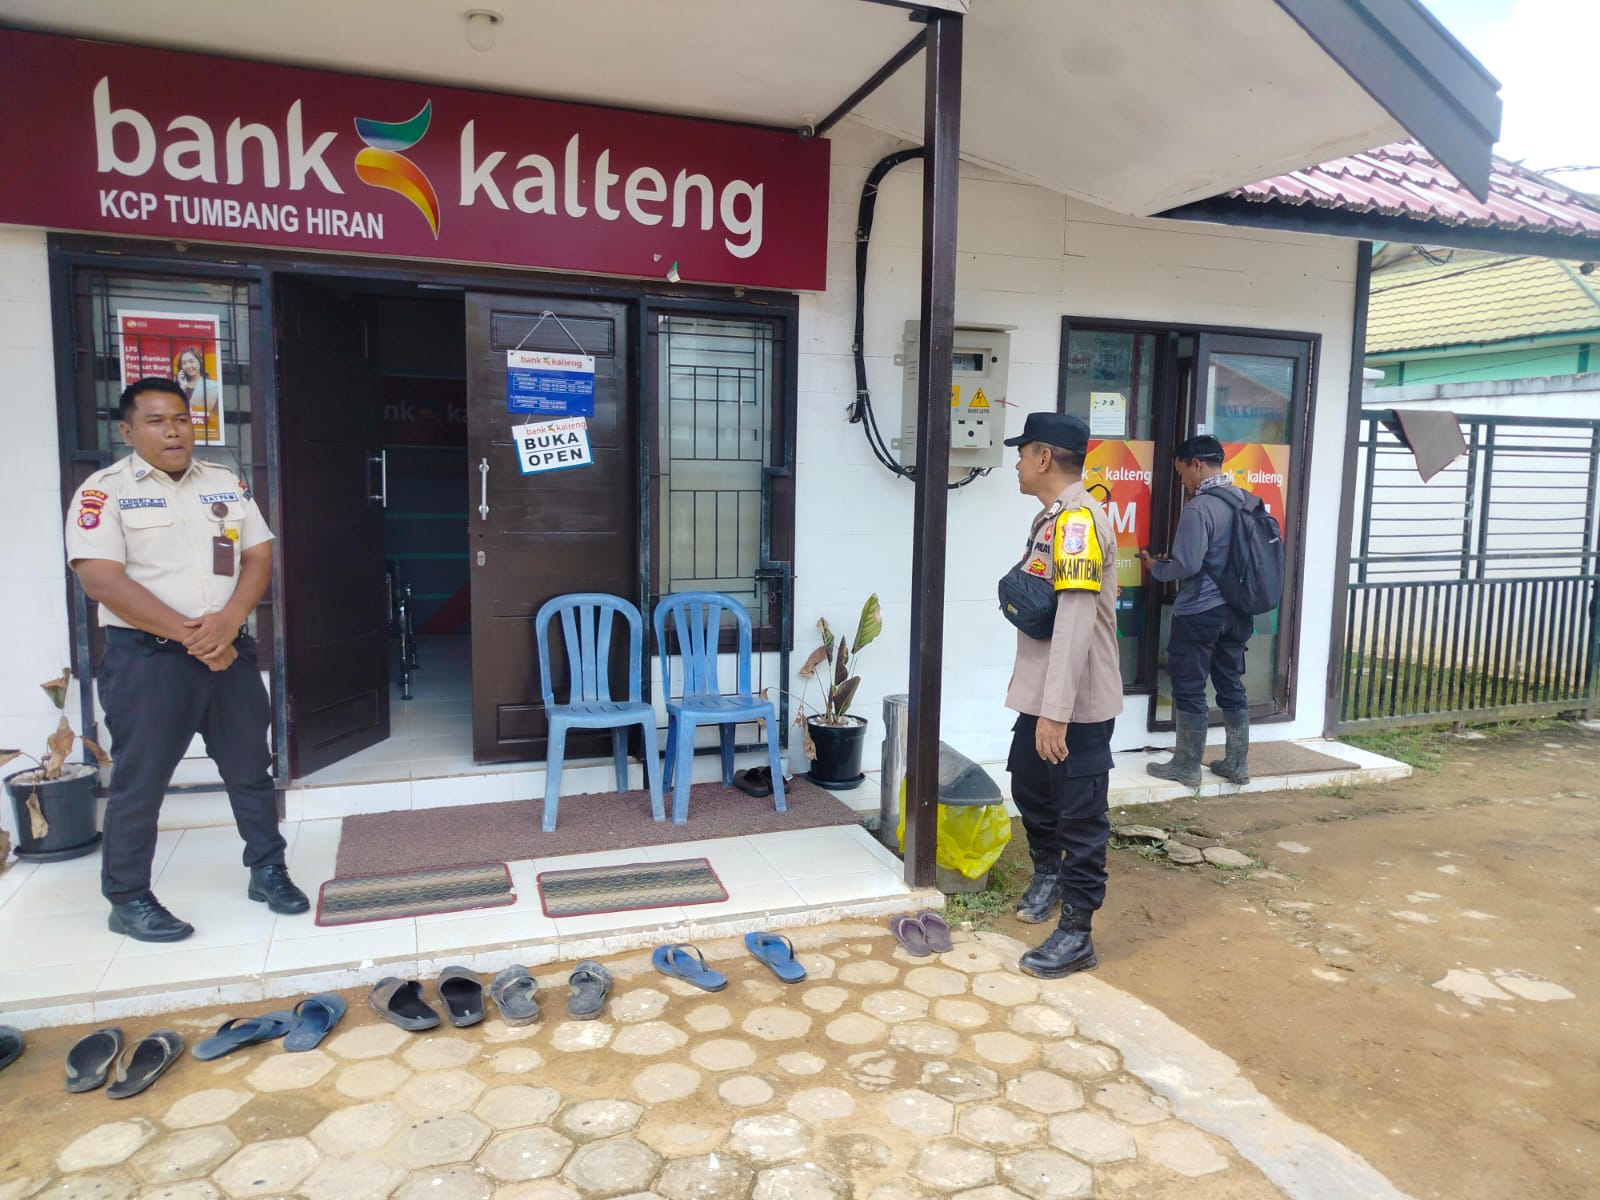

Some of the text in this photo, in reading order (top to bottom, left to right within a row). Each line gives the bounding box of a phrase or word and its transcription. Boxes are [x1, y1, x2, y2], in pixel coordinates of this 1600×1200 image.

[93, 75, 764, 259] bank kalteng
[99, 189, 384, 239] KCP TUMBANG HIRAN
[521, 356, 582, 369] bank kalteng
[526, 420, 586, 436] bank kalteng
[524, 432, 579, 450] BUKA
[528, 448, 583, 466] OPEN
[1105, 466, 1152, 485] kalteng
[1247, 468, 1283, 487] kalteng
[1115, 560, 1132, 569] am
